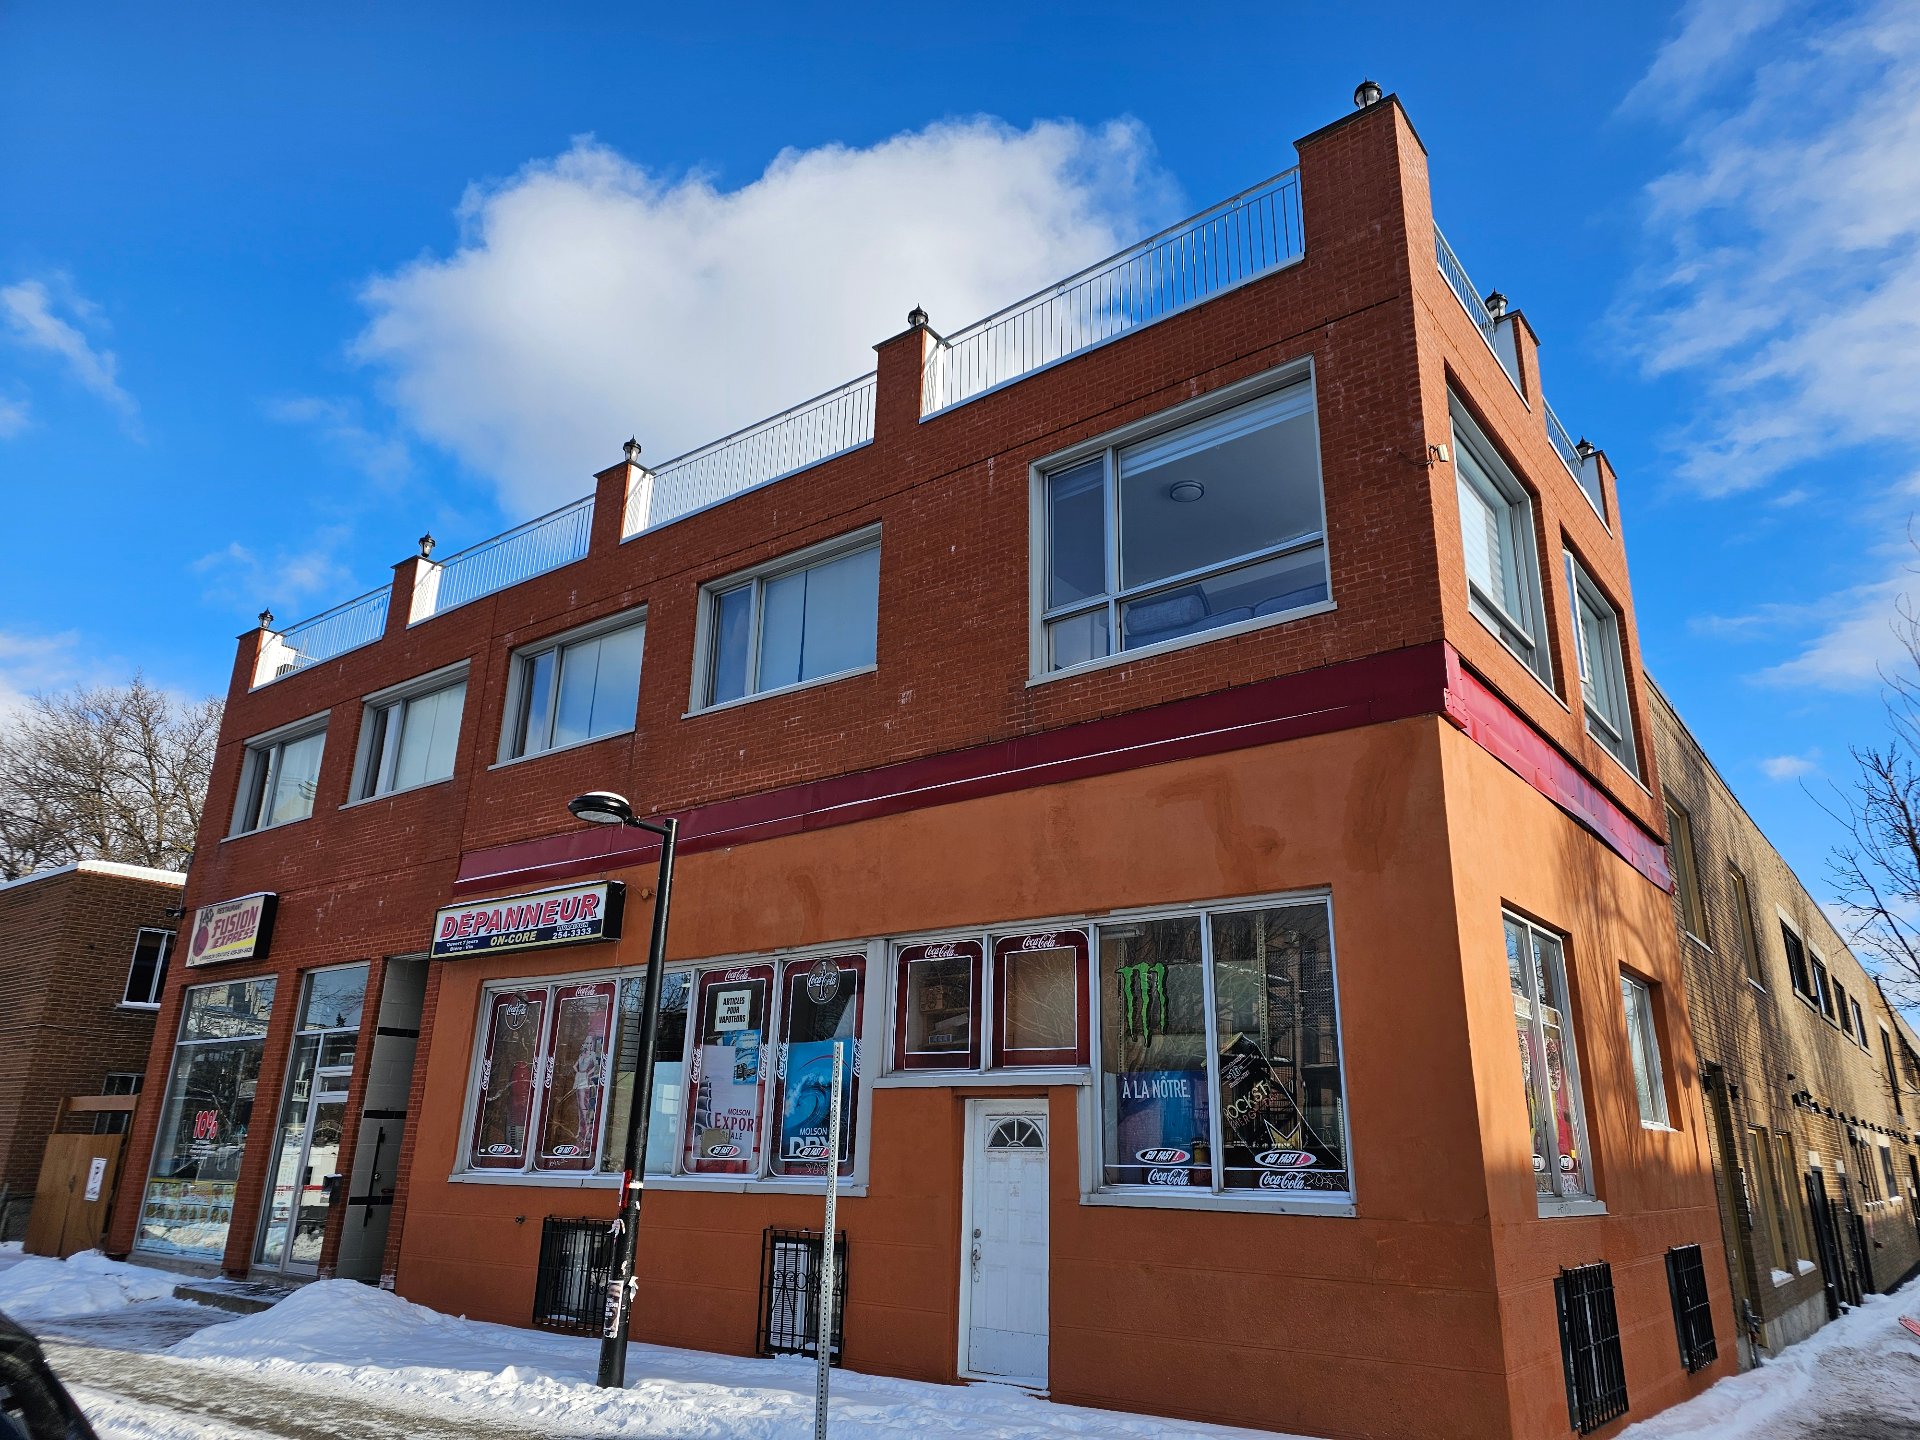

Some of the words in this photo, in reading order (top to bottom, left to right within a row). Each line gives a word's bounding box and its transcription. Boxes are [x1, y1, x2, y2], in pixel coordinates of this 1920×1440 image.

[212, 906, 259, 938] FUSION
[440, 893, 599, 939] DÉPANNEUR
[211, 926, 256, 949] EXPRESS
[490, 931, 537, 946] ON-CORE
[552, 928, 592, 939] 254-3333
[723, 997, 745, 1005] ARTICLES
[726, 1006, 740, 1015] POUR
[1122, 1077, 1131, 1099] À
[1134, 1080, 1149, 1099] LA
[728, 1108, 751, 1116] MOLSON
[193, 1110, 218, 1139] 10%
[800, 1127, 828, 1136] MOLSON
[730, 1132, 743, 1140] ALE
[1264, 1153, 1280, 1164] GO
[1148, 1168, 1190, 1186] Coca-Cola
[1259, 1171, 1307, 1189] Coca-Cola
